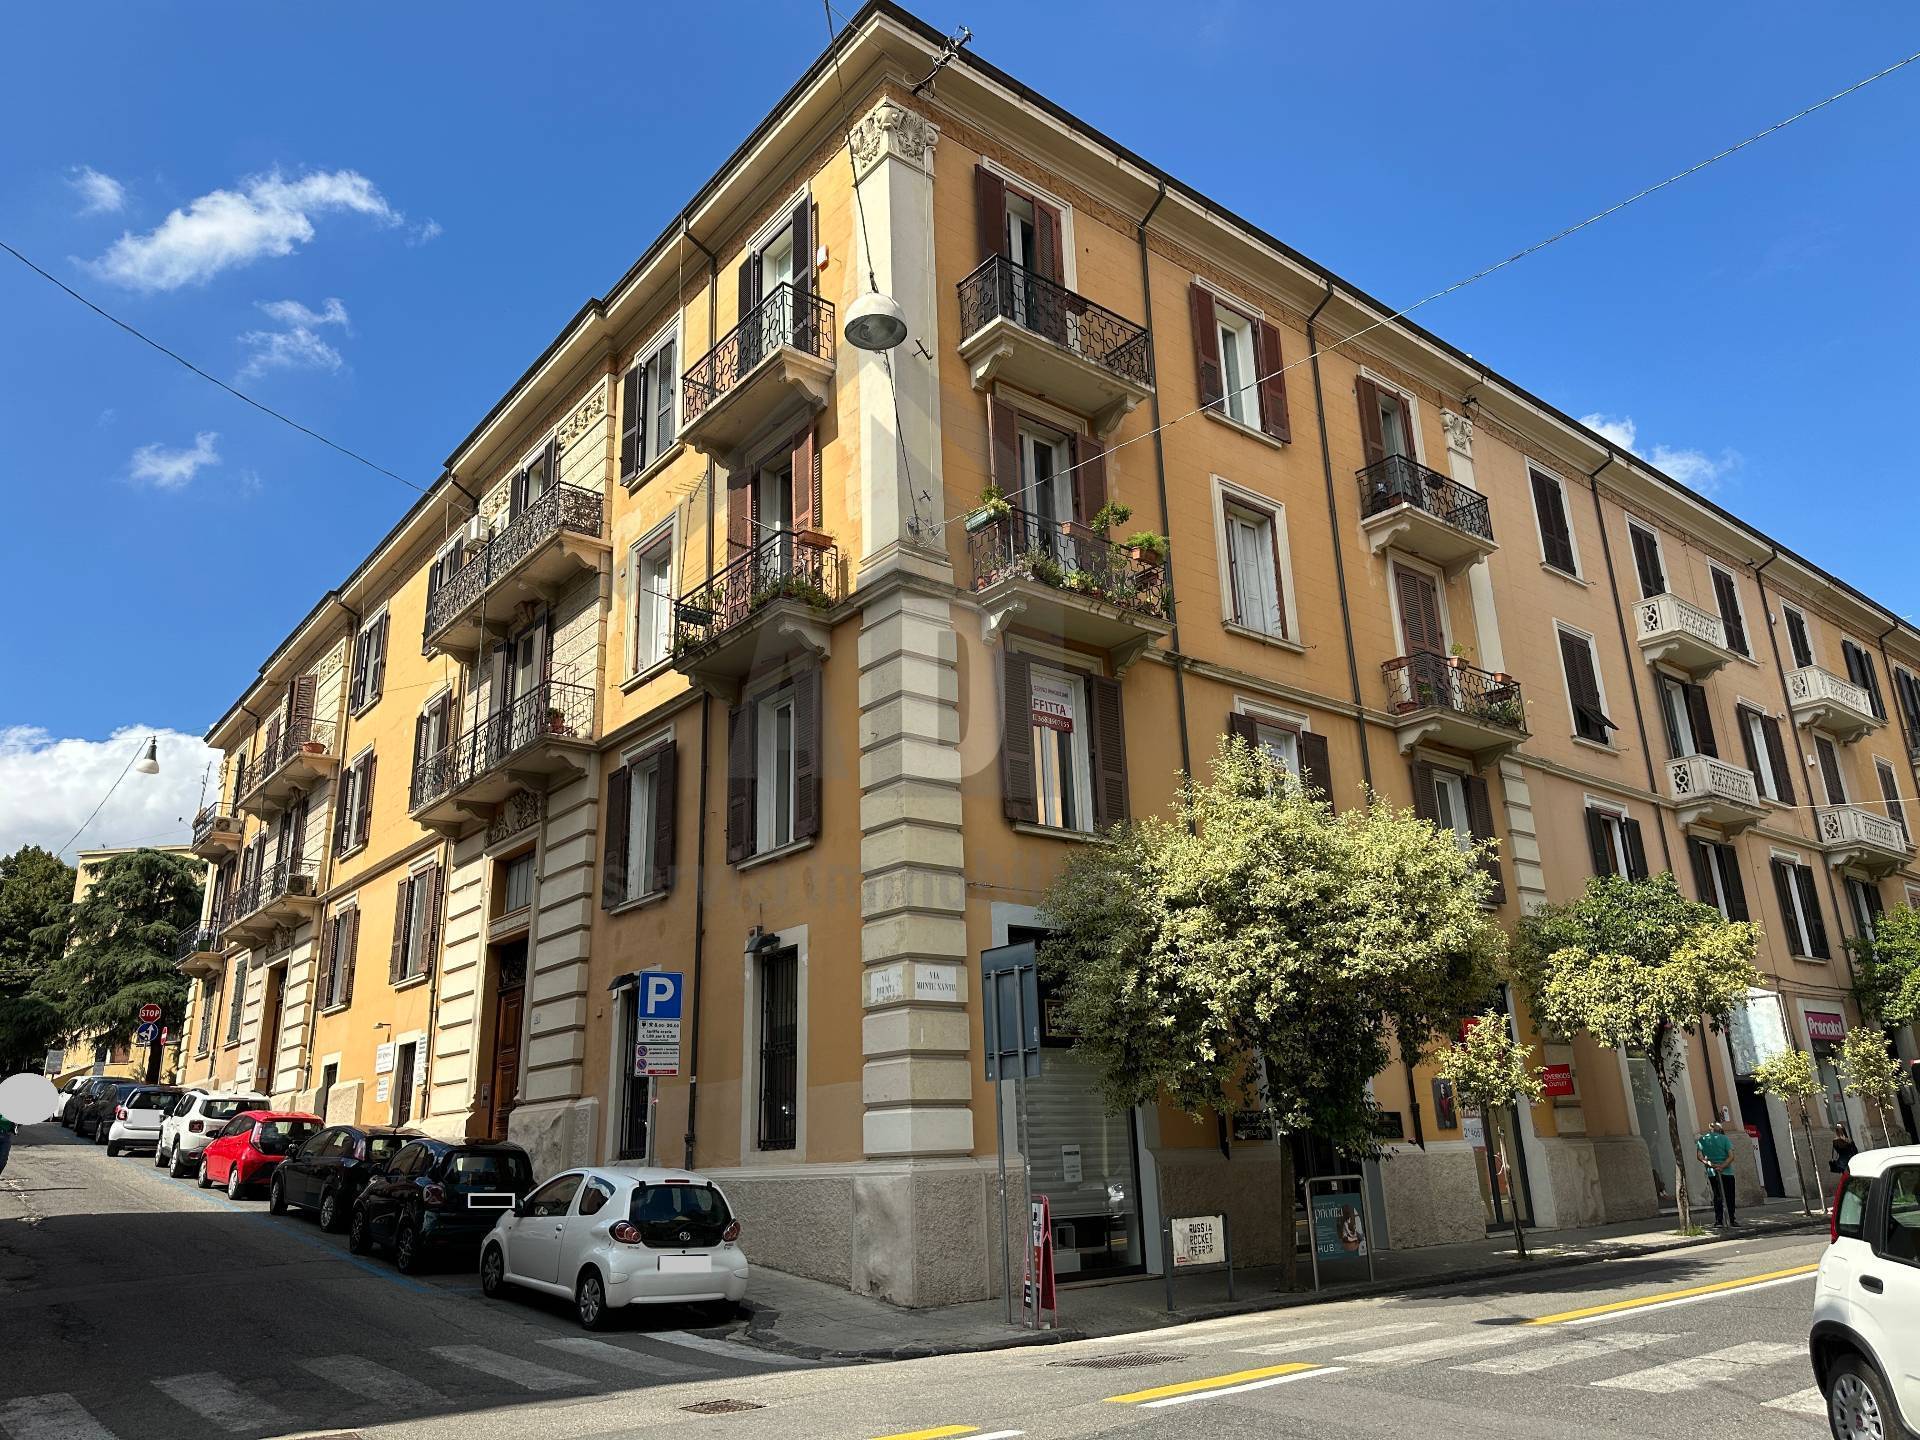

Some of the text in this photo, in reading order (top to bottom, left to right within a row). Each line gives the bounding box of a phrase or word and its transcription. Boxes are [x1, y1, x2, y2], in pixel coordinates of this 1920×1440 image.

[1032, 697, 1066, 716] FFITTA
[929, 971, 940, 980] VIA
[916, 981, 936, 991] MONTE
[646, 976, 675, 1014] P
[141, 1009, 160, 1017] STOP
[1188, 1222, 1213, 1233] RUSSIA
[1189, 1233, 1213, 1245] ROCKET
[1190, 1244, 1214, 1256] TERROR
[1318, 1243, 1335, 1255] HUB
